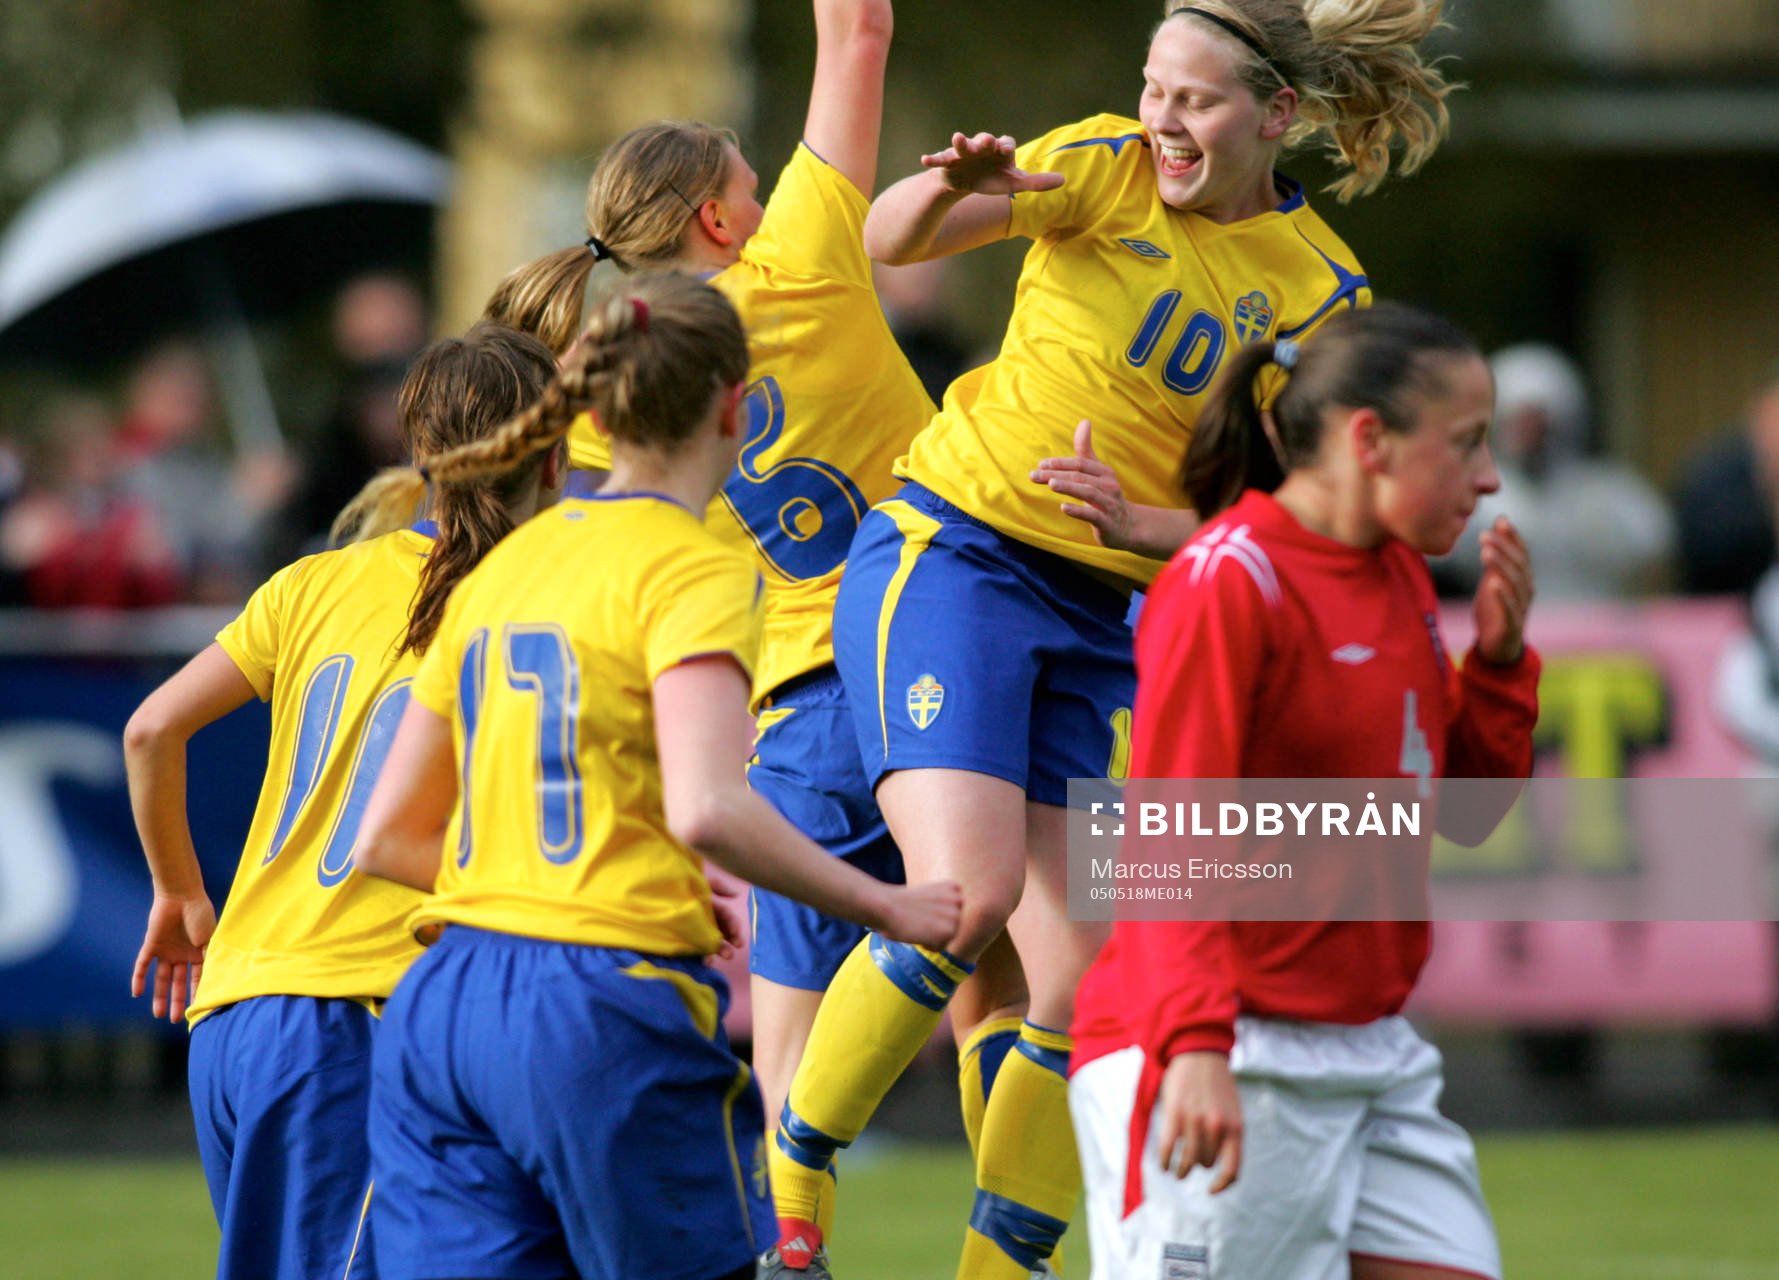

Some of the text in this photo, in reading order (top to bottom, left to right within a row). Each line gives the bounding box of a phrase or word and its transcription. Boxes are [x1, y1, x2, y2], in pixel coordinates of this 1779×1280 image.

[1125, 288, 1226, 396] 10
[723, 375, 871, 582] 6
[457, 622, 585, 867] 17
[1399, 688, 1434, 799] 4
